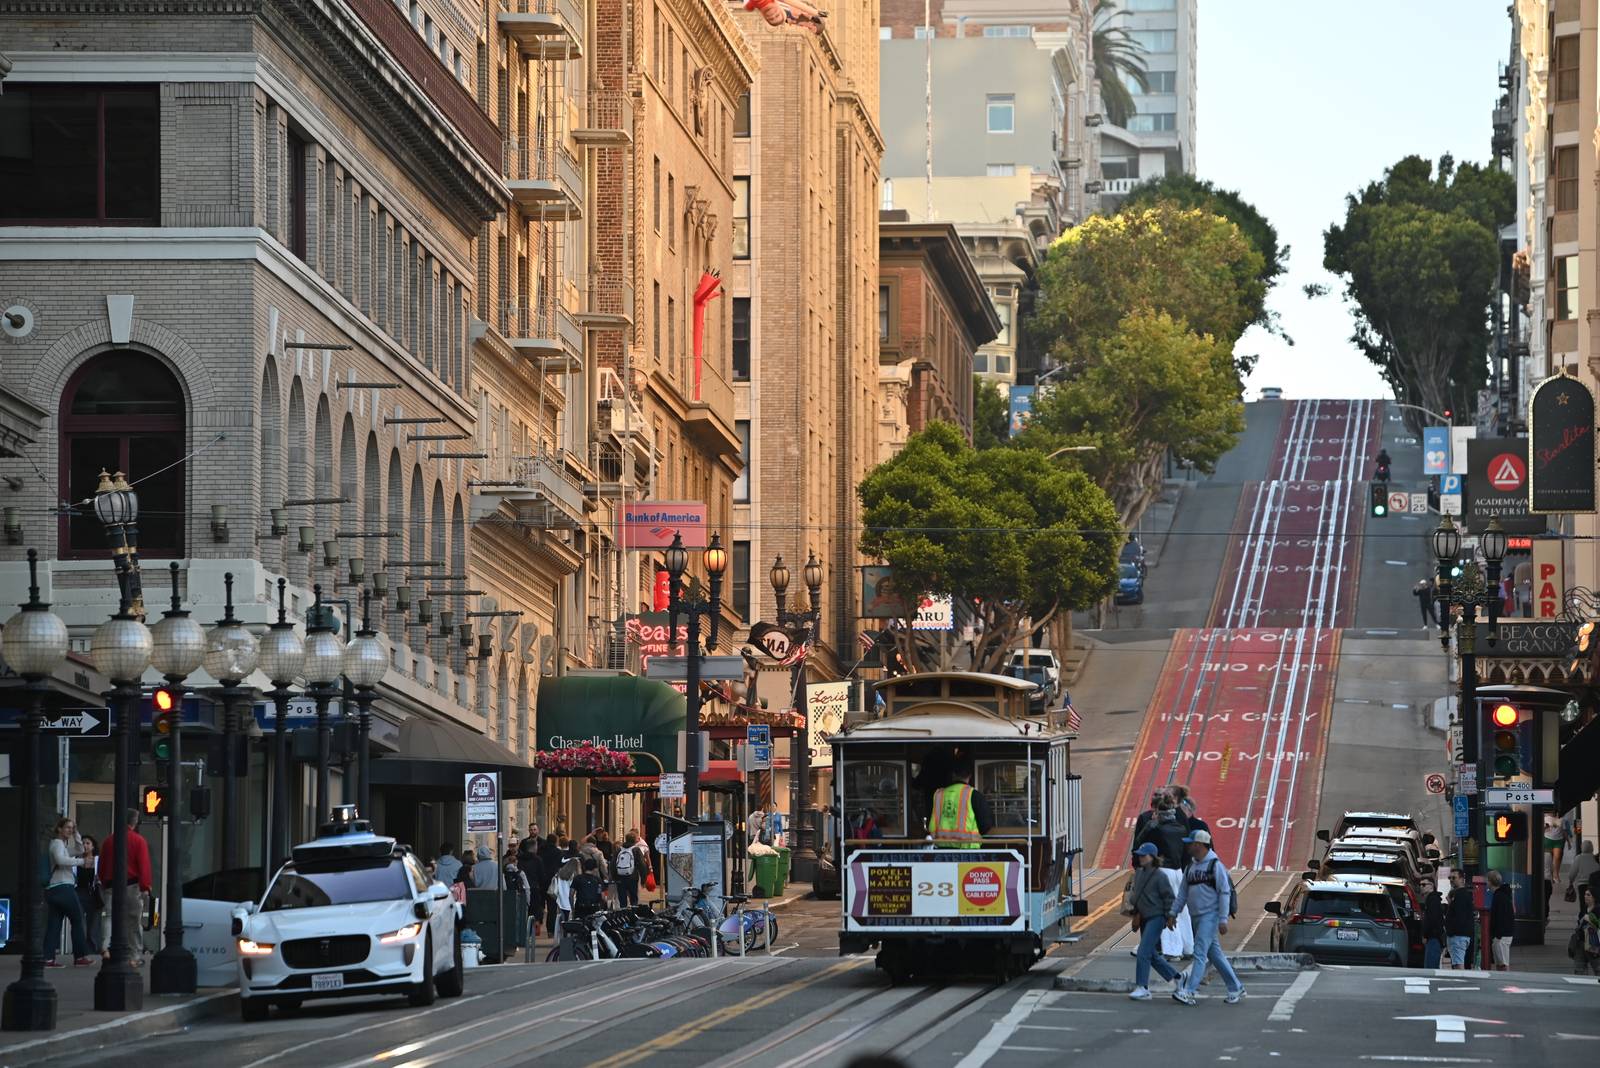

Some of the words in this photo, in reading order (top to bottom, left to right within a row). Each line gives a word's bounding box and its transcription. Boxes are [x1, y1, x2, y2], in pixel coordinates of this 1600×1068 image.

[1515, 497, 1524, 507] of
[1412, 503, 1426, 512] 25
[1474, 507, 1526, 516] UNIVERSI
[626, 513, 649, 523] Bank
[650, 513, 660, 523] of
[661, 513, 700, 523] America
[914, 612, 944, 622] ARU
[624, 619, 689, 643] Seas
[1500, 626, 1571, 641] BEACON
[648, 644, 668, 652] FINE
[1507, 641, 1565, 652] GRAND
[287, 704, 312, 714] Pos
[61, 718, 82, 727] WAY
[550, 735, 612, 749] Challor
[615, 734, 643, 749] Hotel
[1506, 793, 1536, 801] Post
[1216, 818, 1298, 828] ONLY
[918, 882, 954, 897] 23
[190, 945, 226, 954] WAYMO
